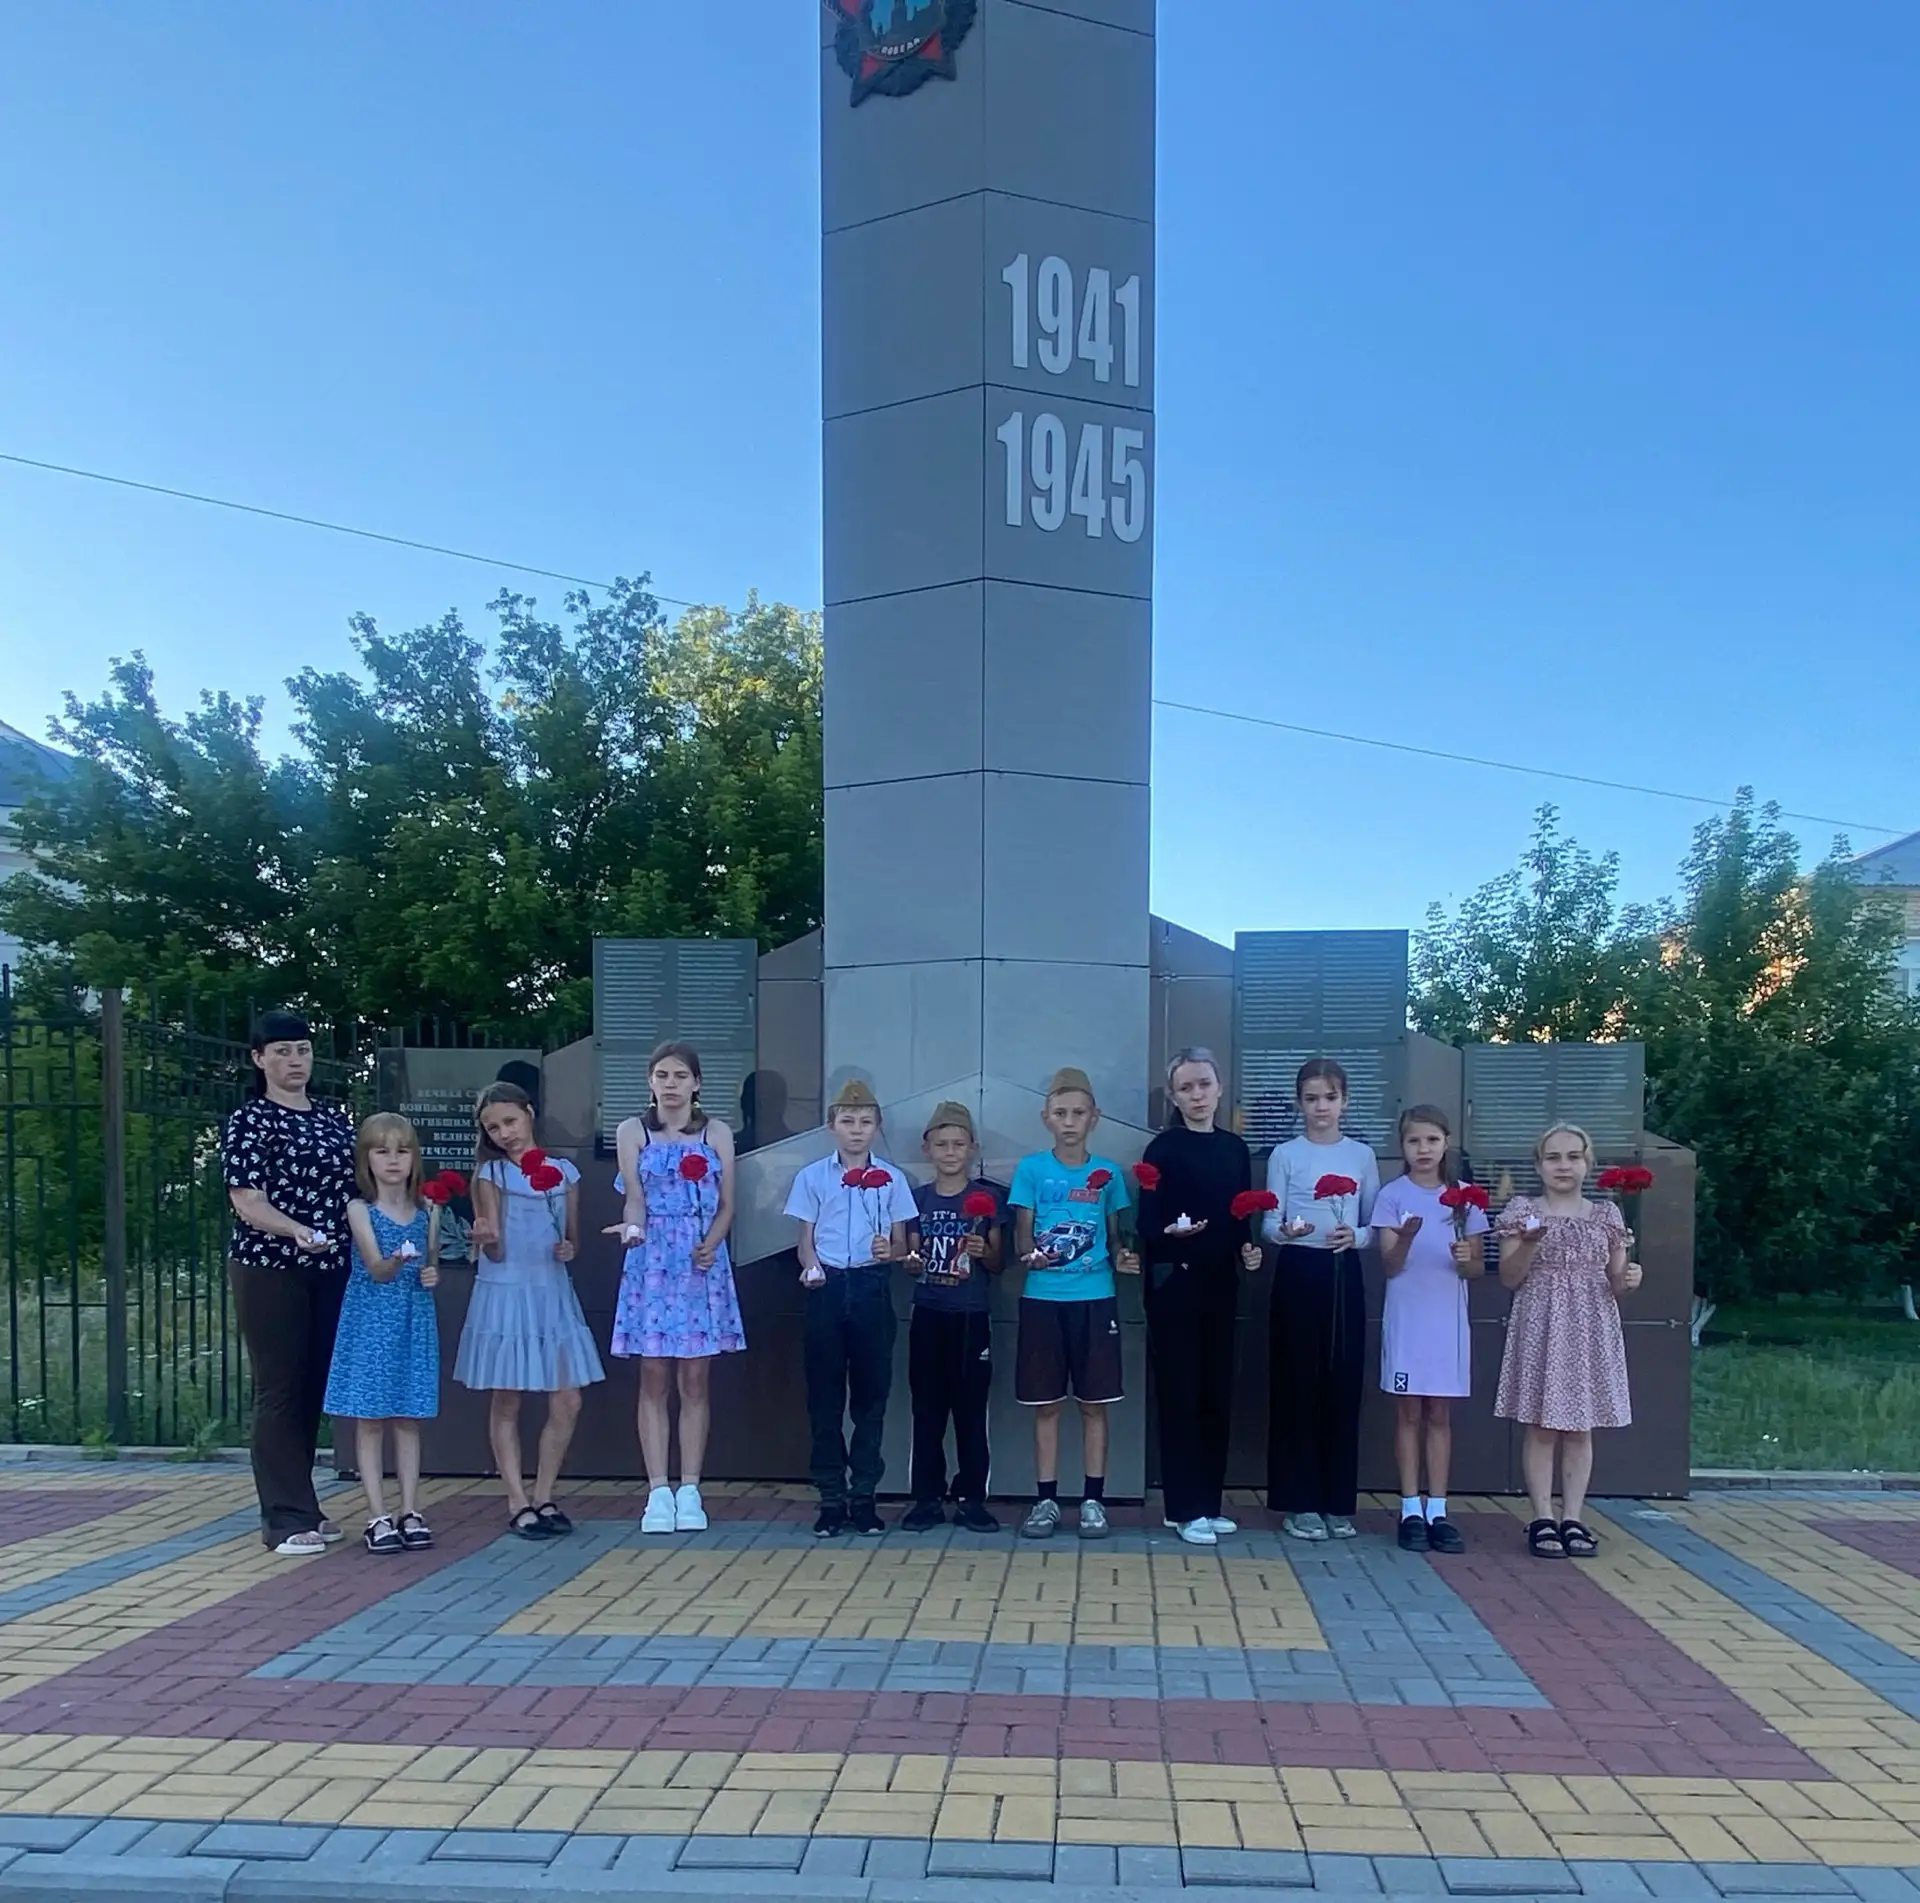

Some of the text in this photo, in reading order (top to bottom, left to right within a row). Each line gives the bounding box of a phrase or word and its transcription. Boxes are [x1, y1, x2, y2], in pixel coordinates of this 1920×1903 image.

[1002, 253, 1140, 387] 1941
[996, 411, 1145, 543] 1945
[433, 1132, 477, 1141] ВЕЛИКО
[420, 1147, 475, 1156] ТЕЧЕСТВ
[921, 1221, 968, 1236] ROCK
